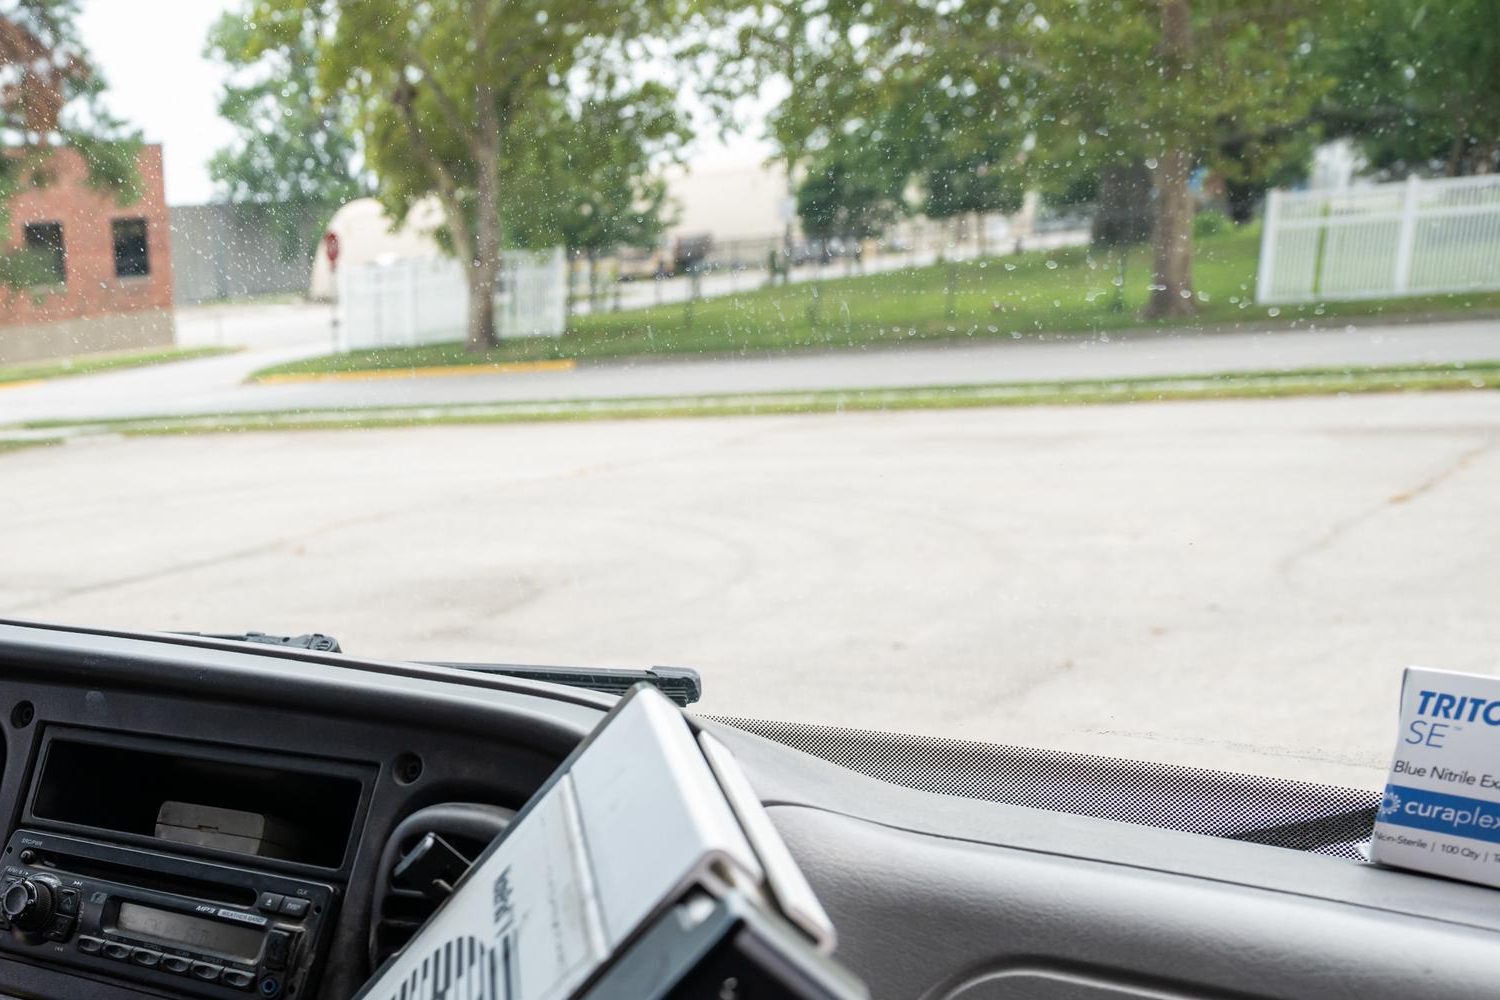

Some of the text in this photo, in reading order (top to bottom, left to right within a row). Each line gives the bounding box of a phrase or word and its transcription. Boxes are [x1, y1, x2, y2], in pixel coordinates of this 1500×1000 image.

[1393, 760, 1427, 777] Blue
[1430, 766, 1476, 786] Nitrile
[1441, 843, 1460, 855] 100
[1460, 847, 1480, 862] Qty
[195, 905, 216, 914] MP3
